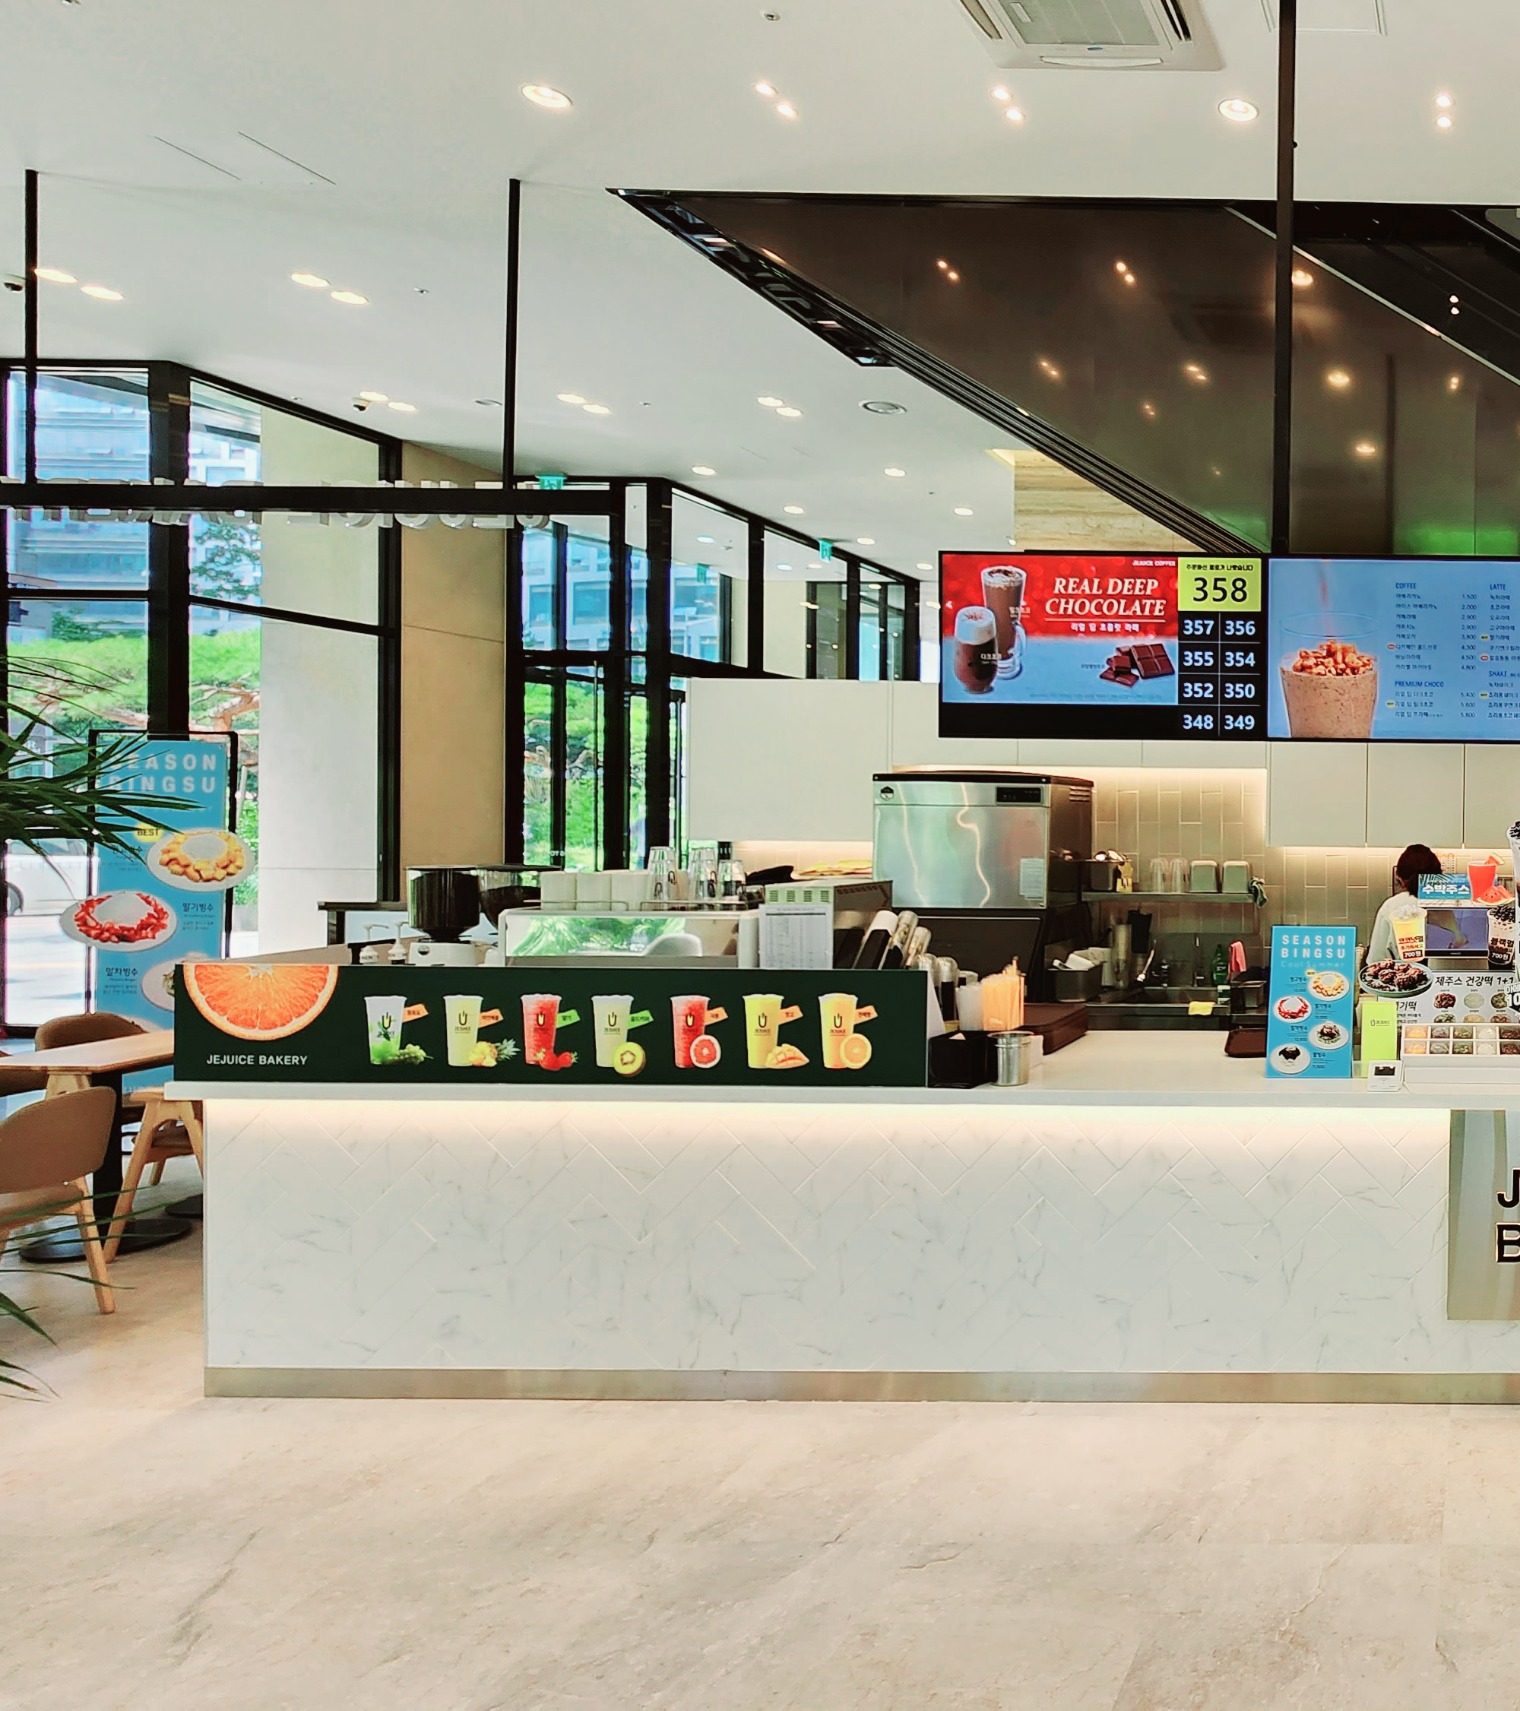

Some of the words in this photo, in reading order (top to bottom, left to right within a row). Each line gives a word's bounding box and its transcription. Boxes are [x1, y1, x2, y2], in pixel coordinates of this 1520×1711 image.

[1053, 577, 1103, 595] REAL
[1106, 577, 1159, 595] DEEP
[1192, 577, 1248, 603] 358
[1395, 582, 1417, 590] COFFEE
[1045, 598, 1167, 617] CHOCOLATE
[1183, 620, 1214, 635] 357
[1224, 620, 1256, 635] 356
[1183, 651, 1214, 667] 355
[1224, 651, 1256, 667] 354
[1183, 682, 1214, 698] 352
[1224, 683, 1256, 698] 350
[1183, 714, 1214, 730] 348
[1224, 715, 1256, 730] 349
[108, 754, 217, 771] EASON
[108, 776, 217, 794] BINGSU
[137, 828, 159, 837] BEST
[1422, 884, 1470, 895] 수박주스
[1281, 934, 1346, 946] SEASON
[1281, 948, 1346, 959] BINGSU
[1404, 950, 1423, 958] 700원
[1491, 951, 1509, 960] 700원
[1435, 976, 1463, 986] 제주스
[1465, 976, 1494, 987] 건강떡
[1497, 976, 1514, 986] 1+1
[207, 1054, 255, 1066] JEJUICE
[258, 1054, 308, 1067] BAKERY
